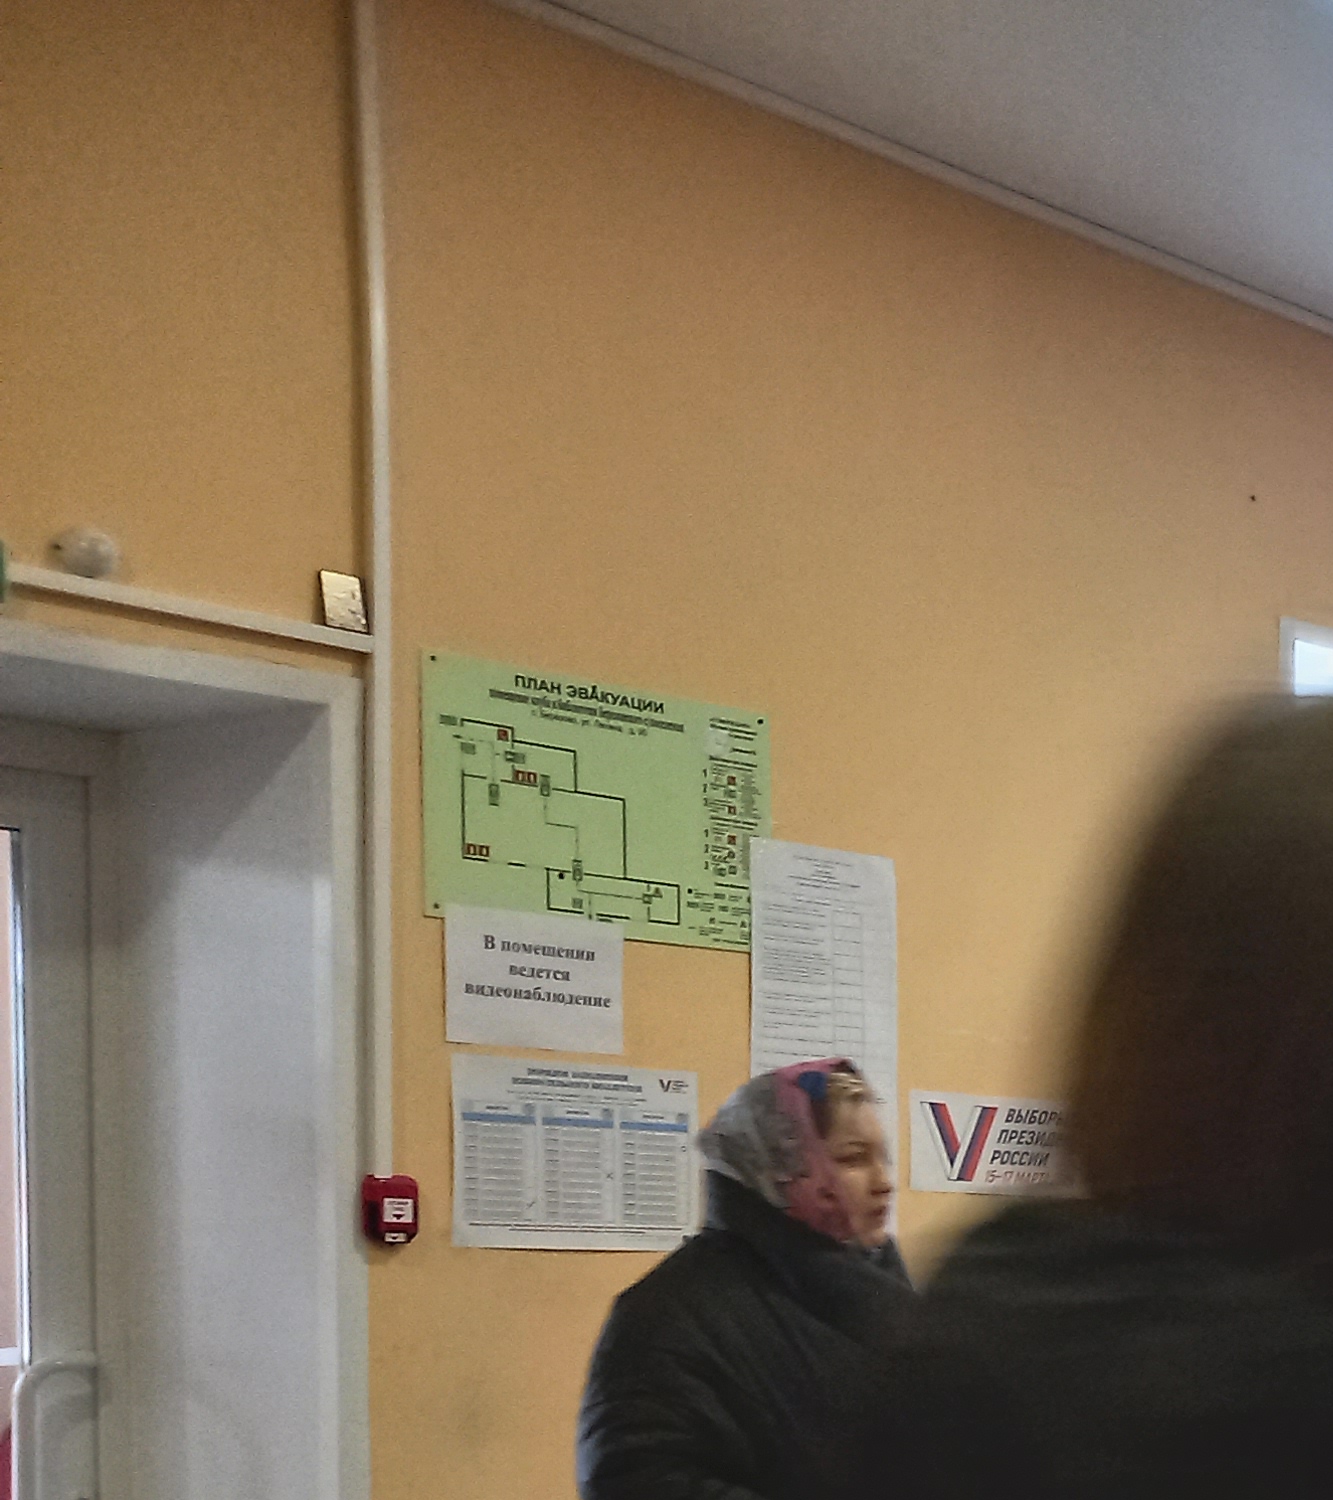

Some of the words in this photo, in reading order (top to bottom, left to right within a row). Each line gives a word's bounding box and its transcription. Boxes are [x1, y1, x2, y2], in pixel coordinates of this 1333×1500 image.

[515, 674, 562, 695] ПЛАН
[566, 684, 665, 714] ЭВАКУАЦИИ
[483, 934, 496, 950] В
[508, 964, 571, 982] ведется
[464, 982, 611, 1008] видеонаблюдение
